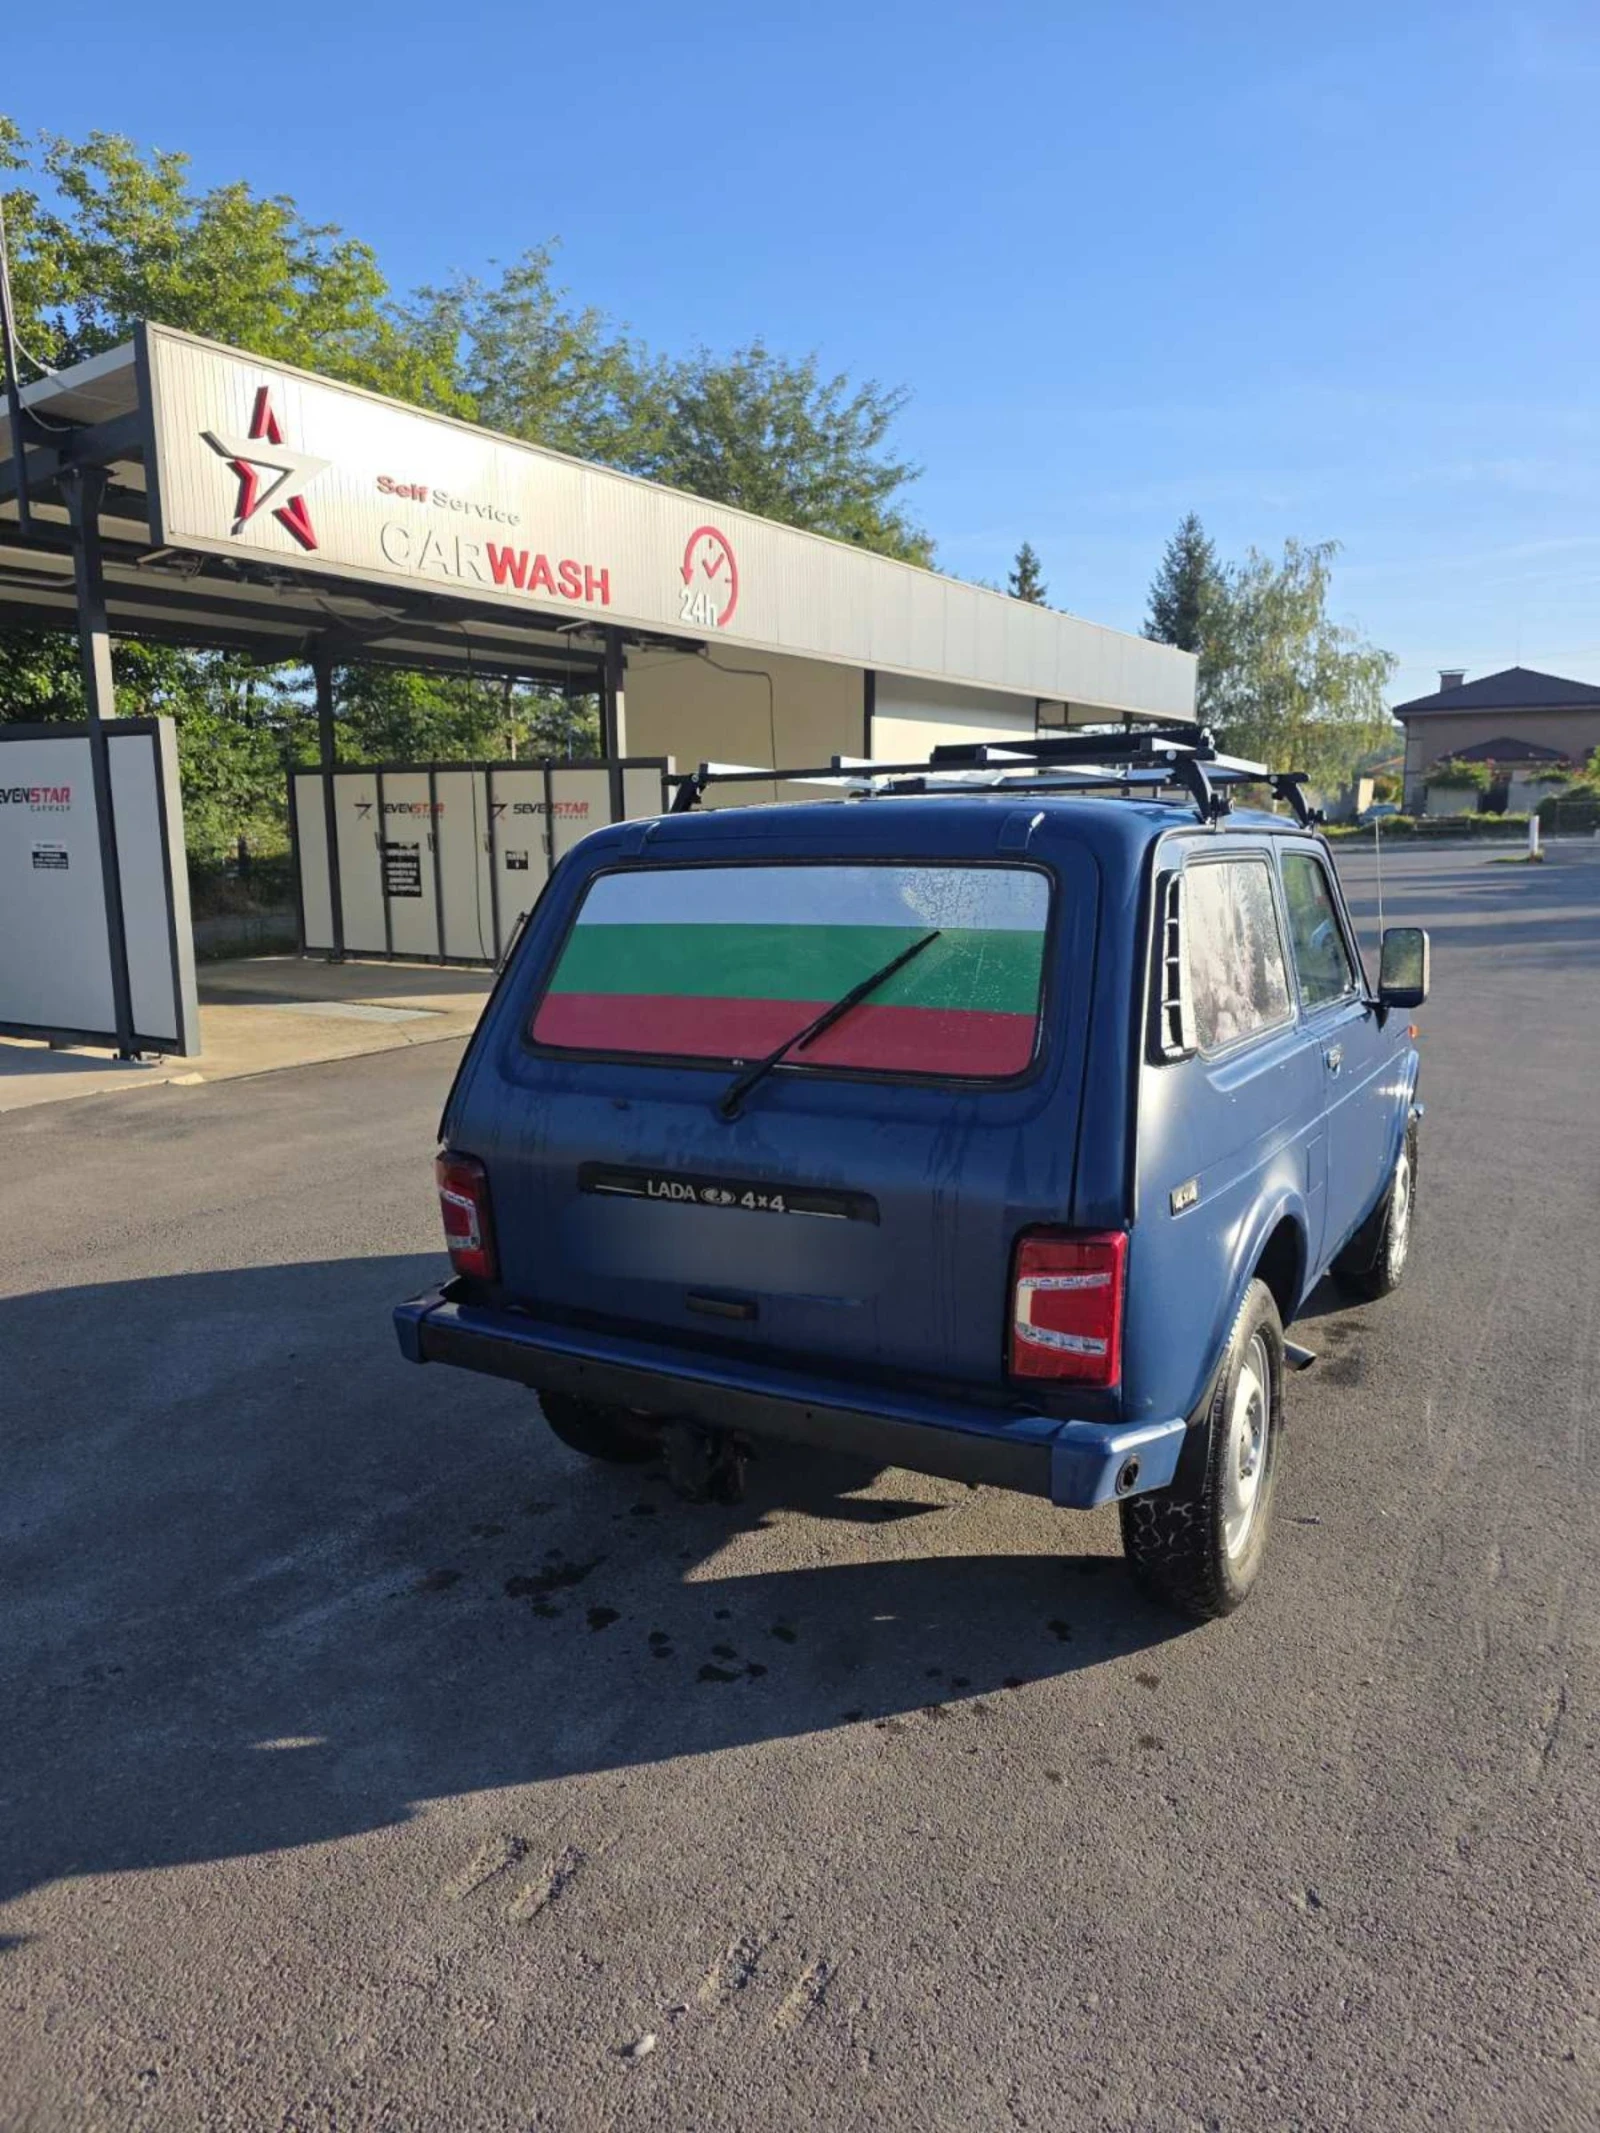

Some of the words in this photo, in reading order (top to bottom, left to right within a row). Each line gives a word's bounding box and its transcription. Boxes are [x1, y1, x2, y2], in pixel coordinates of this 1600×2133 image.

[377, 475, 428, 502] Self
[432, 489, 520, 526] Service
[679, 589, 717, 626] 24h
[647, 1179, 697, 1200] LADA
